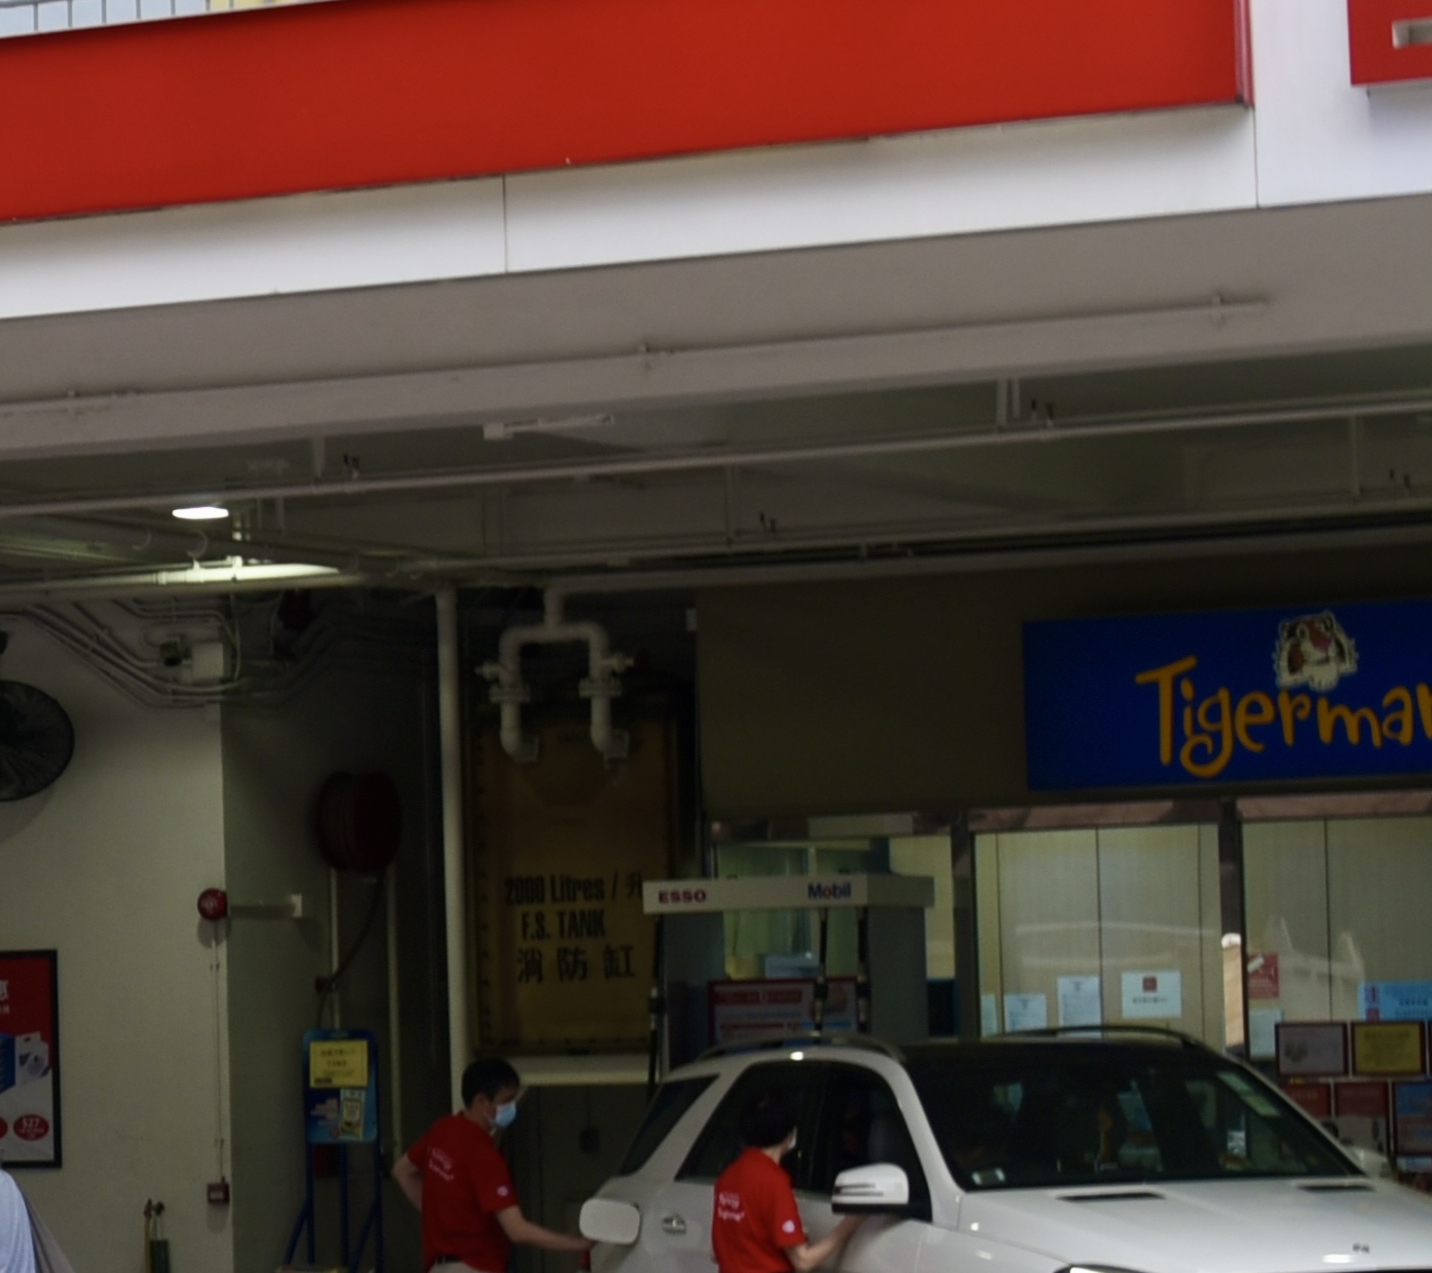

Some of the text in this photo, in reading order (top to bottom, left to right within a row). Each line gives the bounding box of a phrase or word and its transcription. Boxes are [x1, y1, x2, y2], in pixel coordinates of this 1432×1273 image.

[505, 875, 545, 906] 2000
[550, 874, 605, 903] Litres
[658, 882, 851, 904] ESSO Mobil
[521, 909, 606, 941] F.S. TANK
[517, 944, 636, 984] 消防缸
